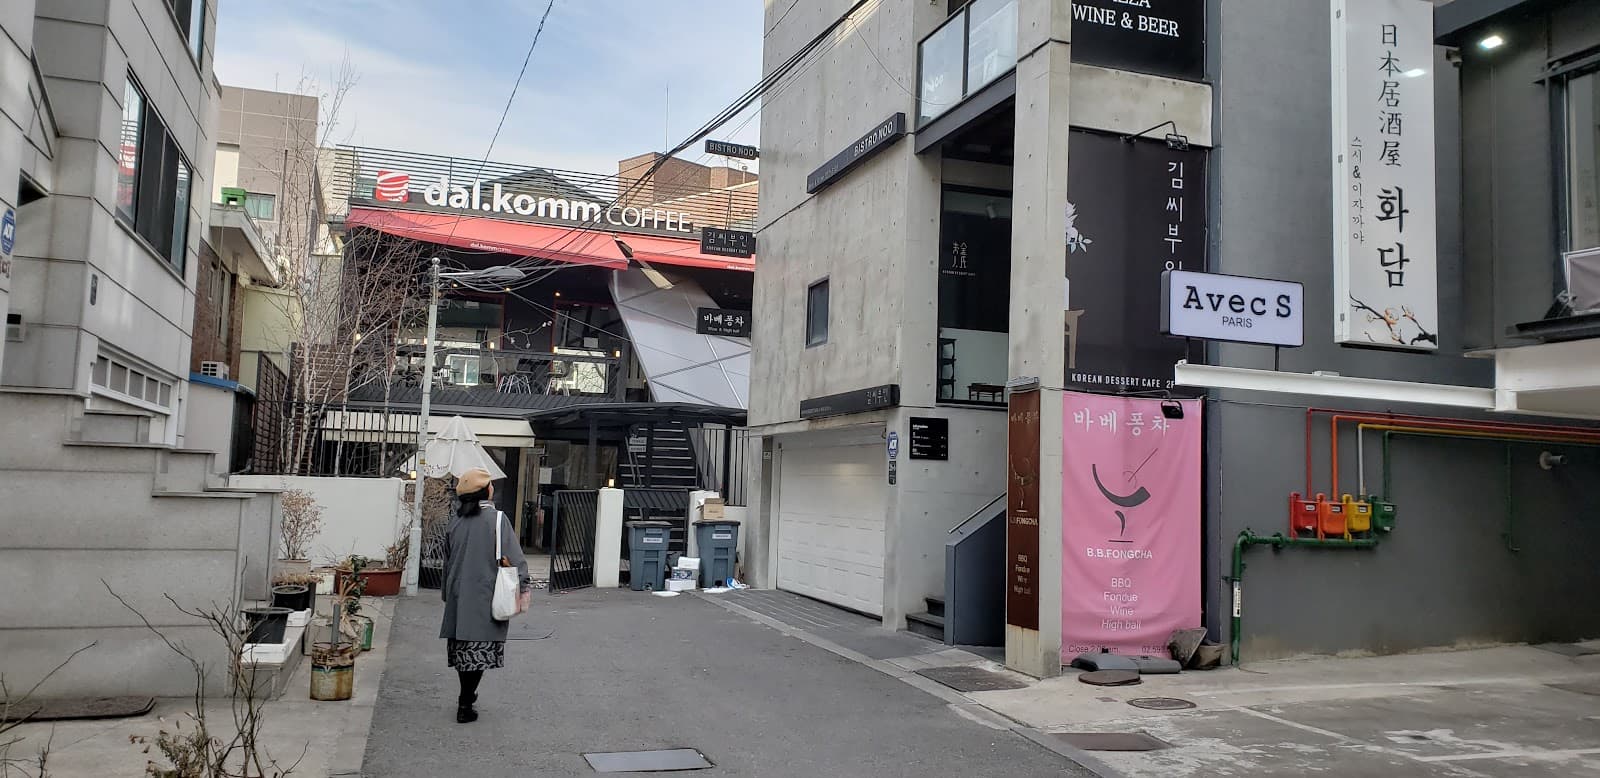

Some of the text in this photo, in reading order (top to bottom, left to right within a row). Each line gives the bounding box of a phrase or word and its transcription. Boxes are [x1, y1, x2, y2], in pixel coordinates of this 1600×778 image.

[1072, 3, 1116, 26] WINE
[1121, 12, 1133, 29] &
[1138, 15, 1179, 37] BEER
[1378, 24, 1402, 167] 日本居酒屋
[854, 121, 893, 157] BISTRO NOO
[709, 143, 754, 157] BISTRO NOO
[423, 177, 692, 233] dal.komm COFFEE
[706, 231, 748, 247] 김씨부인
[1375, 186, 1410, 288] 화담
[703, 313, 744, 327] 바베퐁차
[1222, 316, 1253, 328] PARIS
[1071, 372, 1102, 384] KOREAN
[1105, 375, 1140, 386] DESSERT
[1142, 378, 1160, 388] CAFE
[1073, 407, 1170, 437] 바베퐁차
[1086, 547, 1152, 559] B.B.FONGCHA
[1111, 577, 1131, 588] BBQ
[1103, 591, 1138, 602] Fondue
[1109, 605, 1134, 616] Wine
[1101, 620, 1123, 632] High
[1068, 643, 1089, 654] Close
